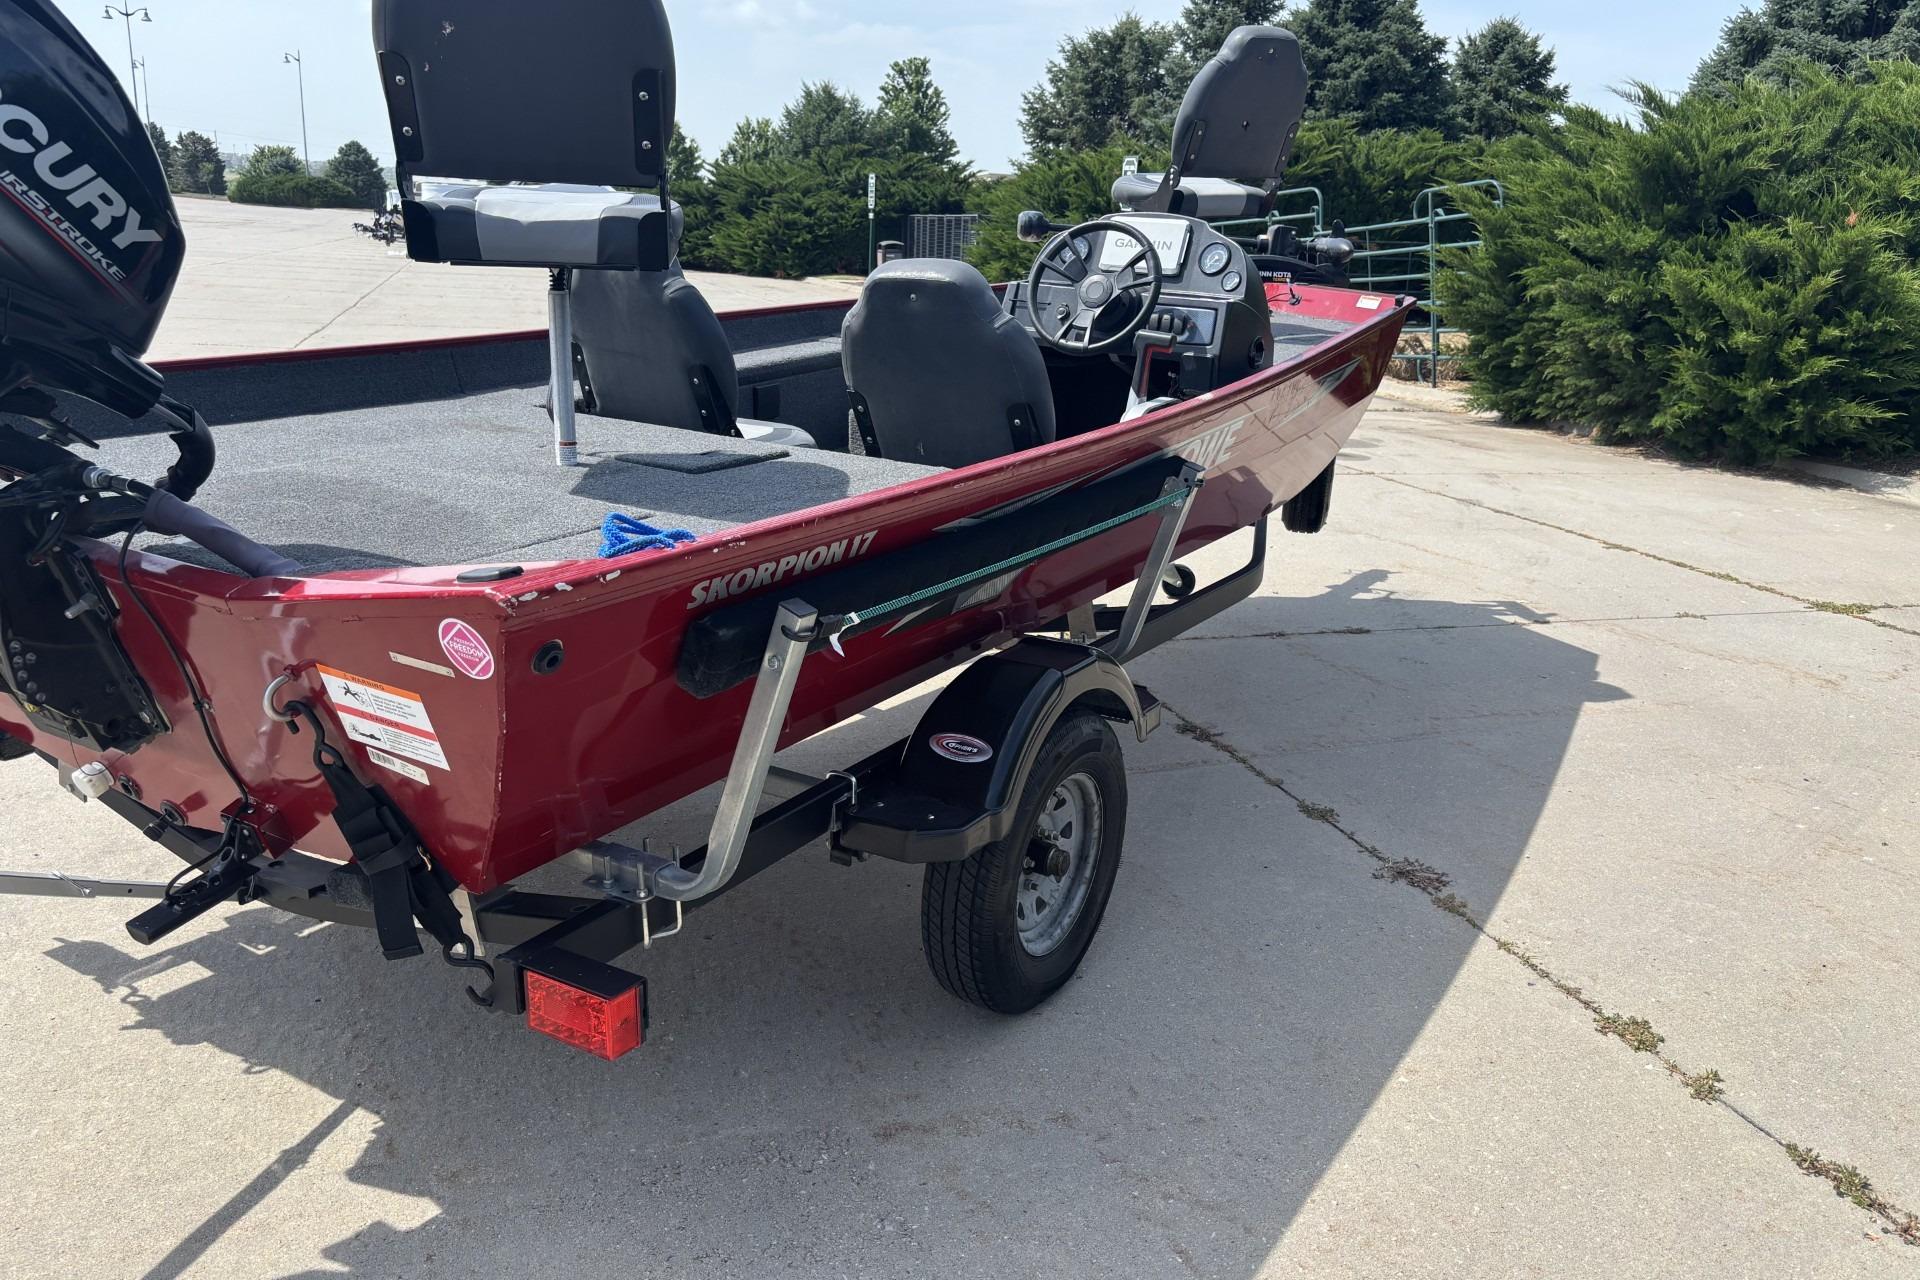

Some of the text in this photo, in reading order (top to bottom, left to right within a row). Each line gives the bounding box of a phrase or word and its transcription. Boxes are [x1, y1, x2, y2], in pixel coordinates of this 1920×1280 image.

[0, 92, 163, 250] CURY
[1115, 238, 1173, 251] GAIN
[1178, 420, 1244, 467] OWE
[687, 529, 878, 610] SKORPION 17
[351, 675, 385, 691] WARNING
[369, 714, 400, 728] DANGER
